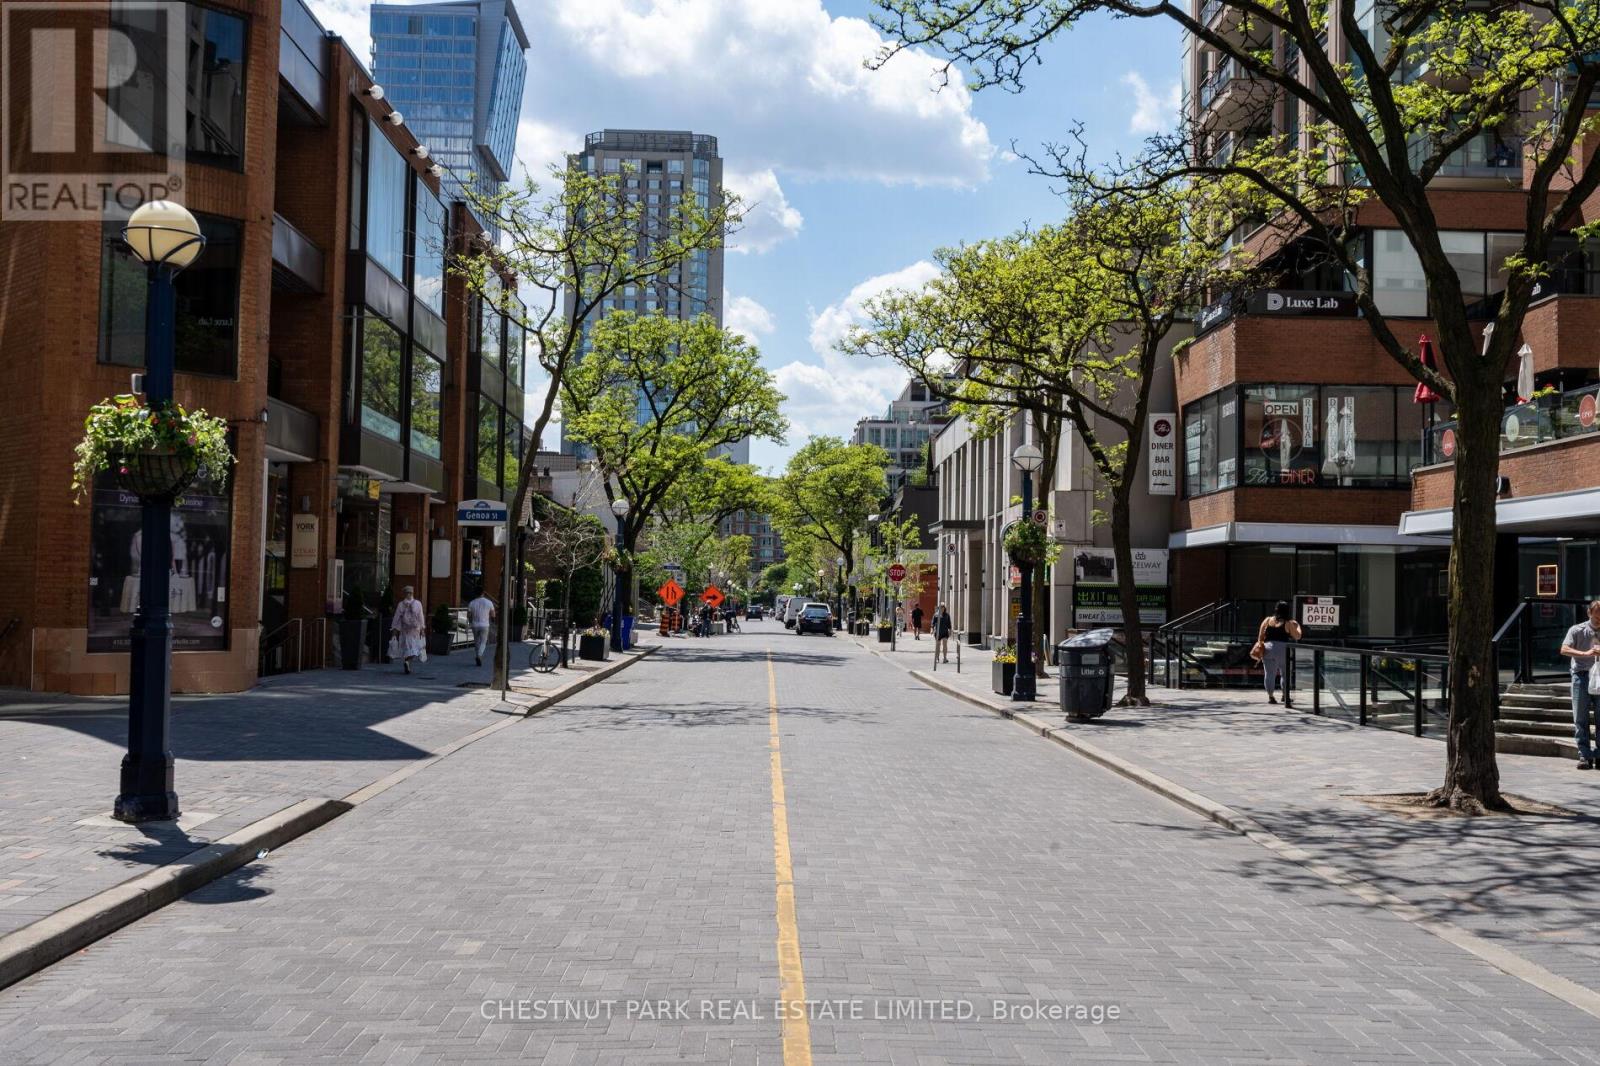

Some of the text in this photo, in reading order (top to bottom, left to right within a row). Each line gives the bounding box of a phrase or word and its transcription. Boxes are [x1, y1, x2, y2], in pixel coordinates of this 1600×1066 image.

[1531, 282, 1541, 296] ab
[1286, 297, 1315, 309] Luxe
[1316, 297, 1339, 309] Lab
[1265, 404, 1298, 415] OPEN
[1304, 399, 1312, 446] RITUAL
[1151, 442, 1174, 450] DINER
[1152, 469, 1173, 477] GRILL
[1281, 468, 1315, 485] DINER
[465, 511, 490, 520] Genoa
[296, 522, 315, 530] YORK
[890, 569, 905, 577] STOP
[1307, 606, 1335, 614] PATIO
[1307, 615, 1334, 623] OPEN
